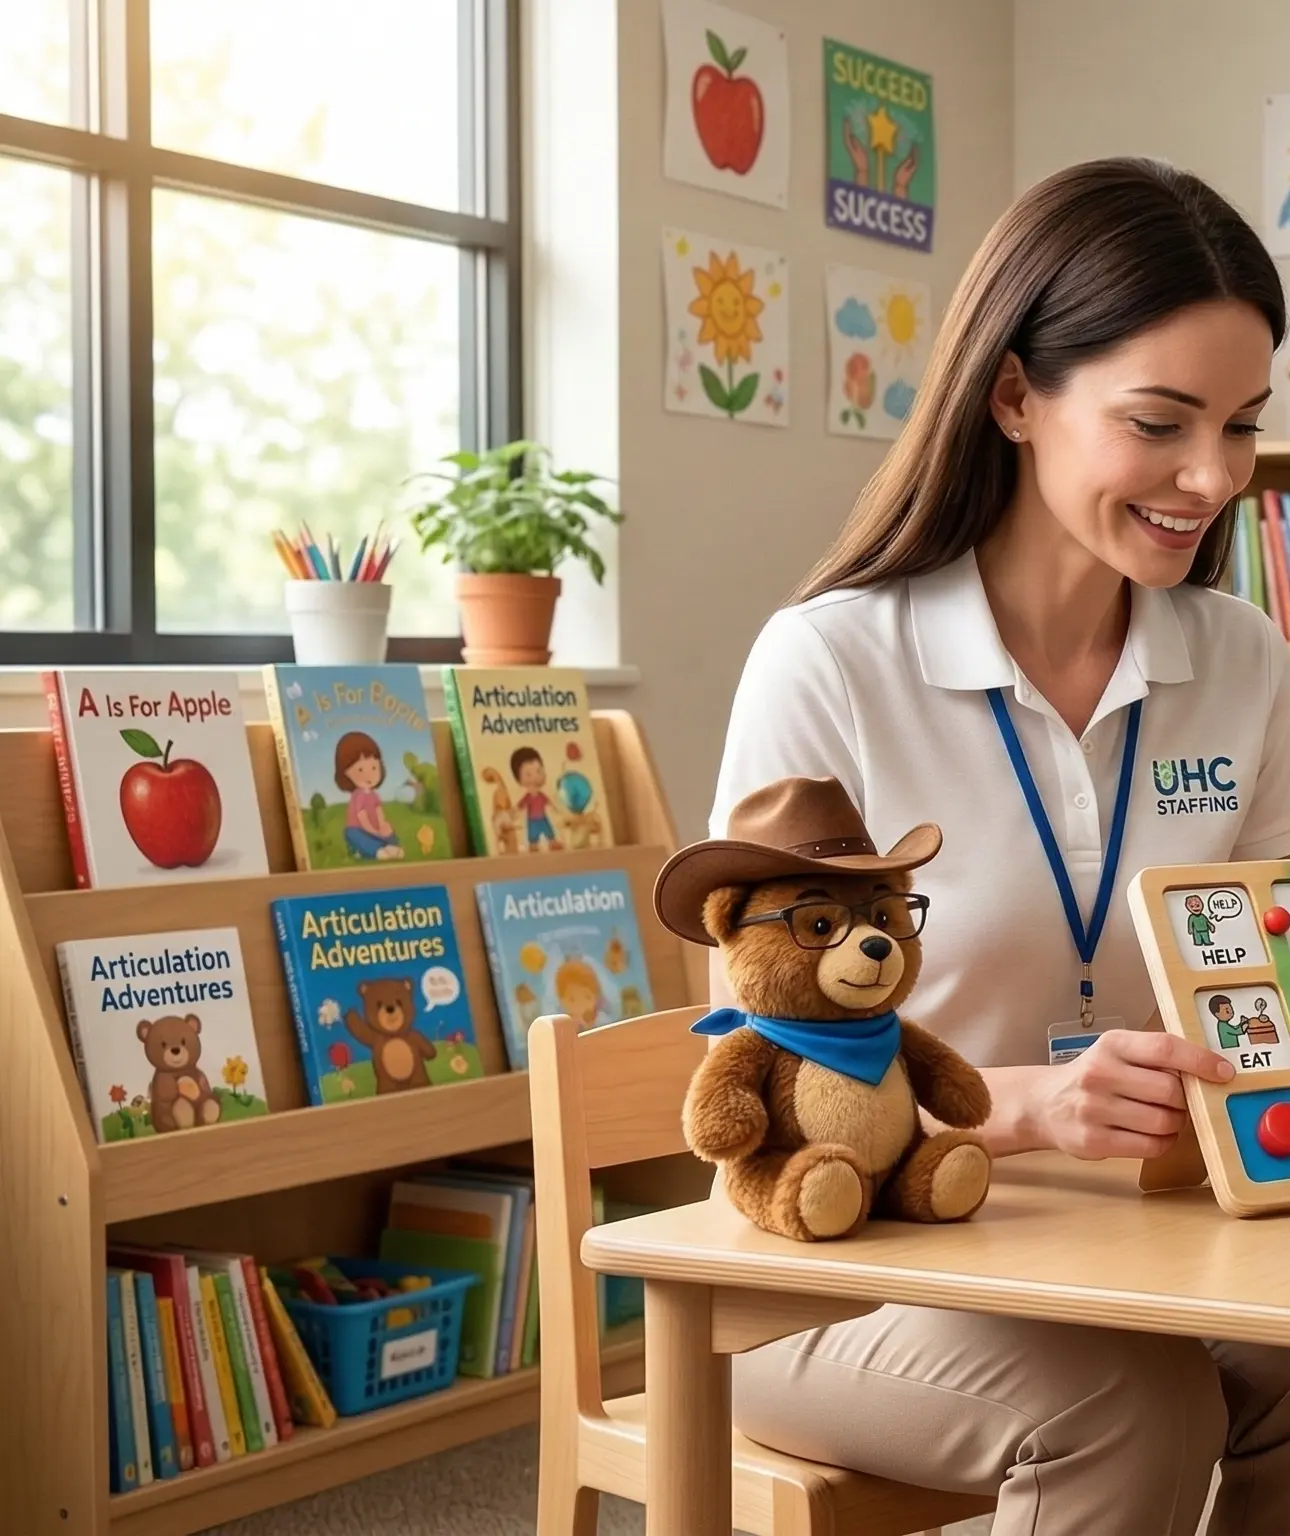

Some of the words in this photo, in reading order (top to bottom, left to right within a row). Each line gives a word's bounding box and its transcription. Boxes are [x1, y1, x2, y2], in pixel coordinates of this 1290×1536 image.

[833, 52, 927, 111] SUCCEED
[834, 187, 927, 243] SUCCESS
[78, 687, 99, 717] A
[106, 695, 124, 717] Is
[129, 695, 161, 717] For
[168, 690, 232, 723] Apple
[473, 684, 577, 708] Articulation
[481, 713, 579, 735] Adventures
[1152, 757, 1237, 796] UHC
[1157, 796, 1238, 815] STAFFING
[503, 885, 625, 920] Articulation
[1212, 898, 1238, 909] HELP
[302, 902, 442, 939] Articulation
[90, 946, 231, 982] Articulation
[311, 934, 444, 971] Adventures
[1201, 947, 1247, 966] HELP
[101, 979, 234, 1012] Adventures
[1239, 1051, 1272, 1069] EAT
